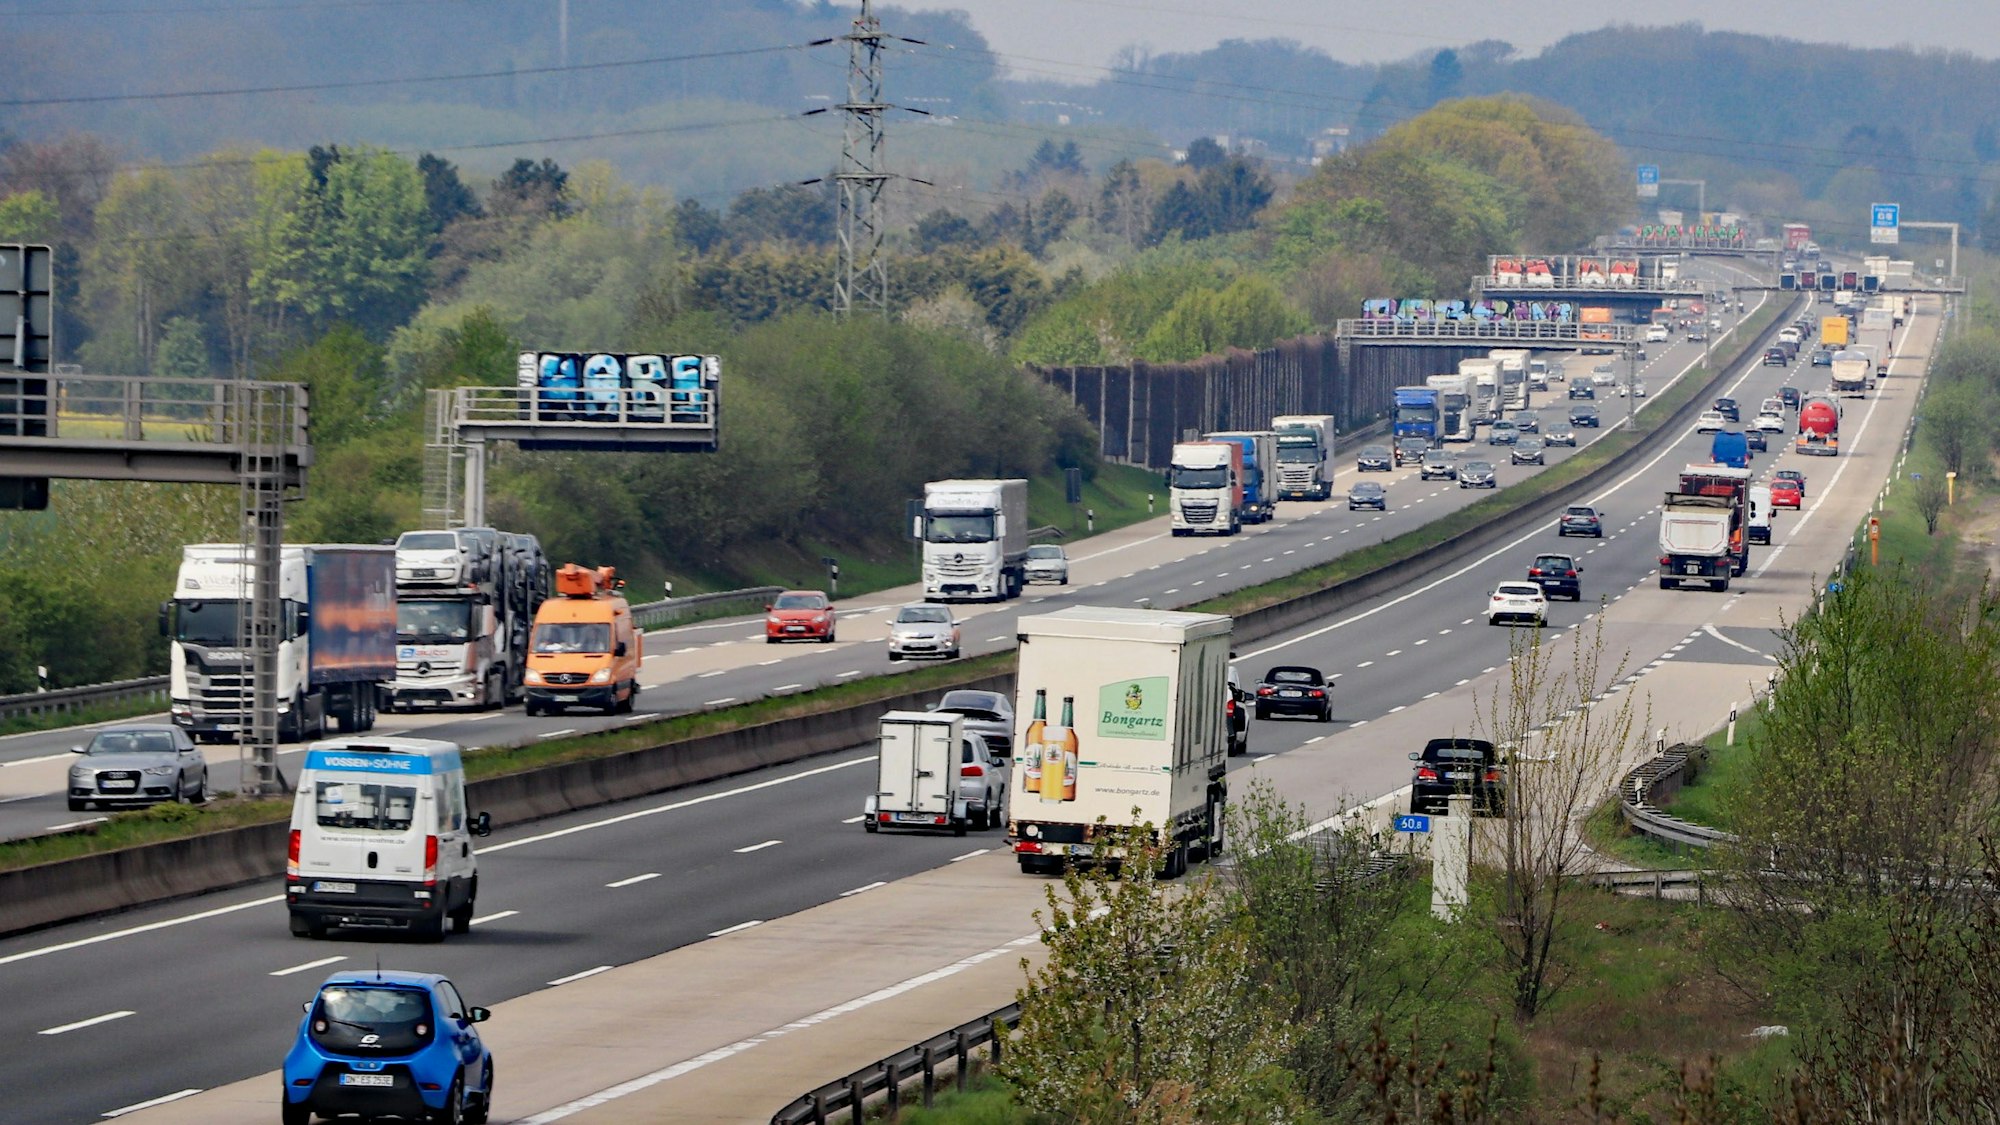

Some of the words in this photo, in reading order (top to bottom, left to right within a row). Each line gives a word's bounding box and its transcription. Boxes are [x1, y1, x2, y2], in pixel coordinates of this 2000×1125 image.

[1102, 711, 1163, 728] Bongartz
[1094, 786, 1160, 796] www.bongartz.de
[1401, 818, 1422, 829] 60.8
